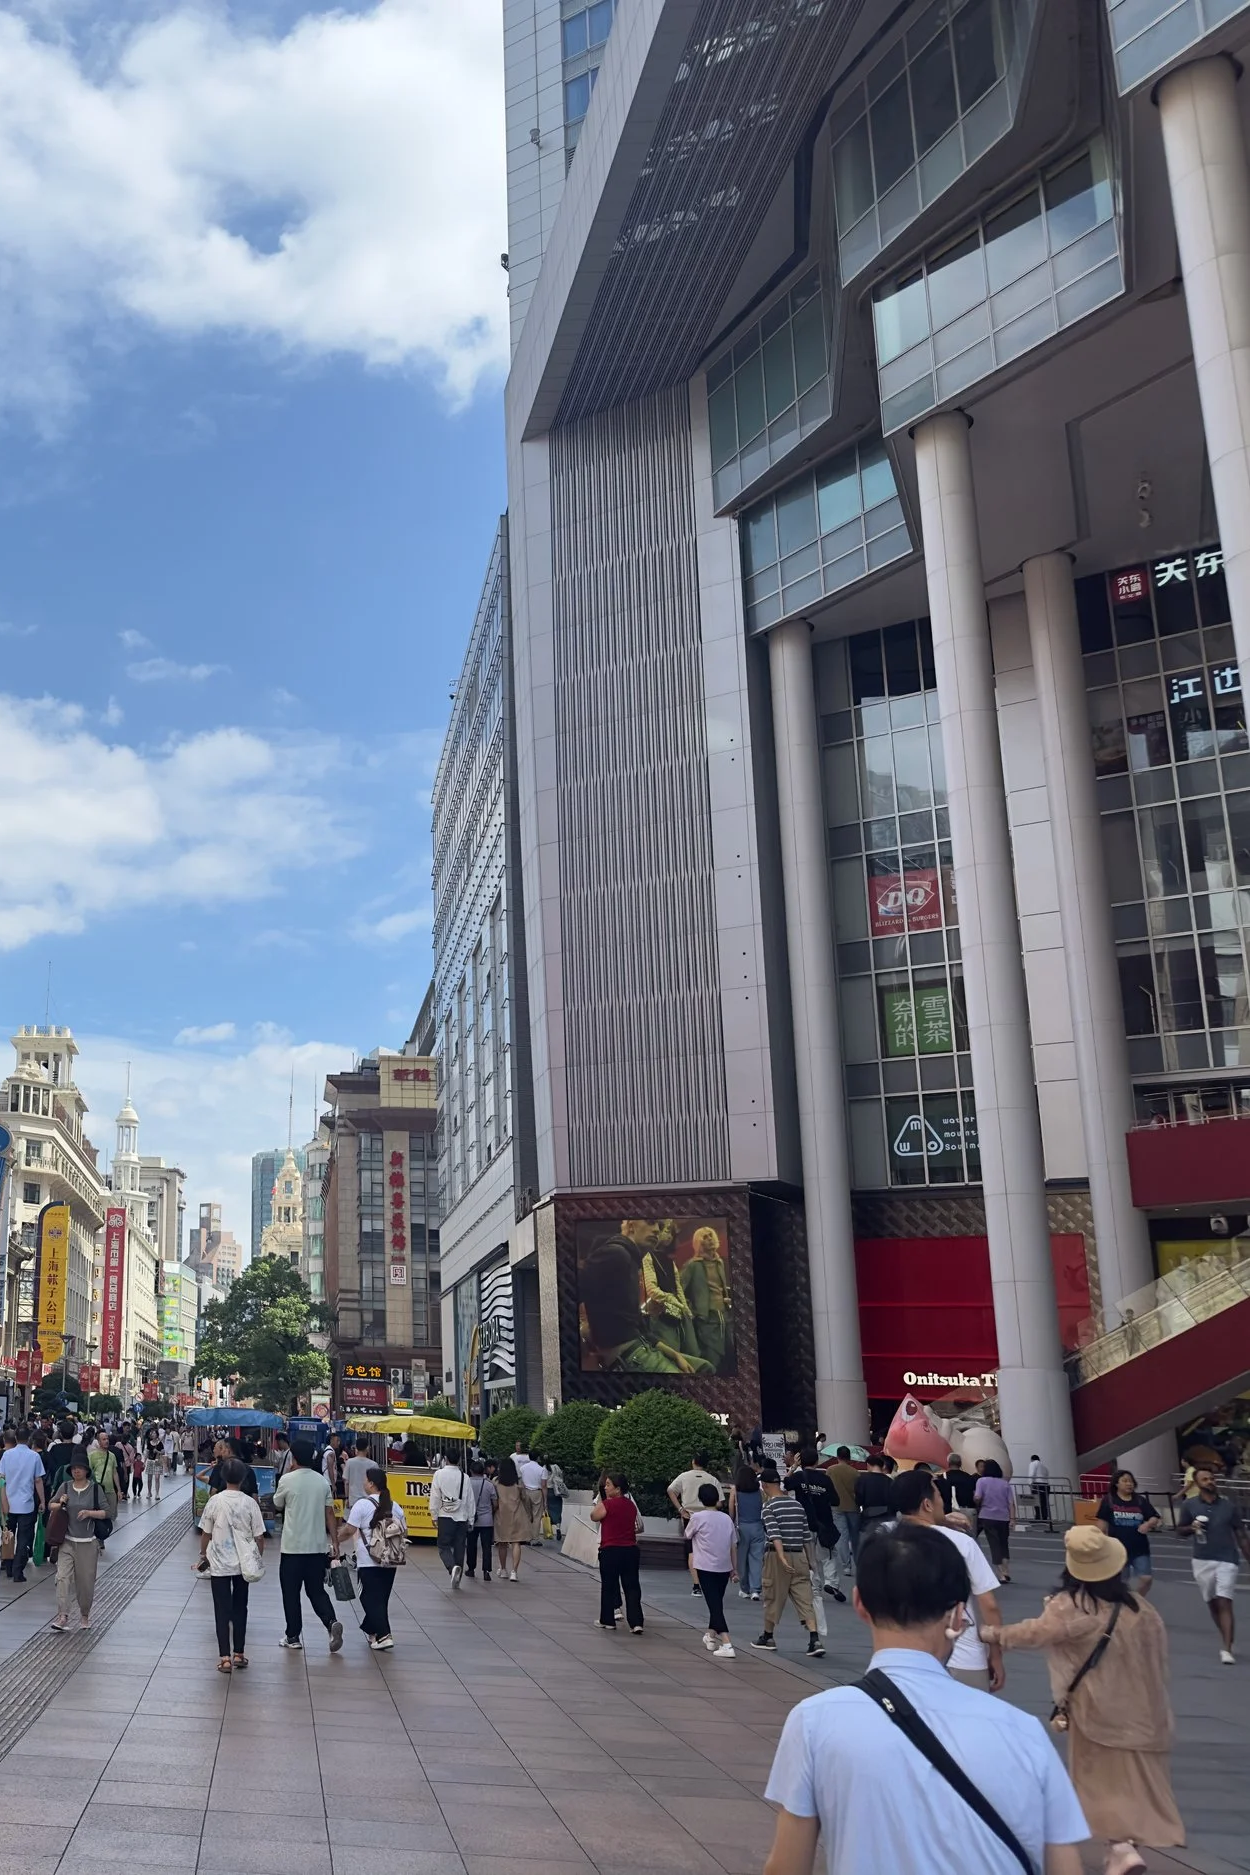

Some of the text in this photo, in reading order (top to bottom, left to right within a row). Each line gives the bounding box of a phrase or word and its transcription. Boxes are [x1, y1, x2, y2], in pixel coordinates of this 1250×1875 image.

[1154, 550, 1225, 588] 关东
[1117, 574, 1141, 587] 关东
[1170, 666, 1242, 705] 江边
[885, 887, 927, 909] DQ
[875, 917, 906, 928] BLIZZARD
[912, 913, 940, 922] BURGERS
[944, 1130, 979, 1138] mount
[345, 1365, 382, 1377] 汤包馆
[903, 1372, 981, 1386] Onitsuka
[708, 1413, 730, 1426] er
[406, 1481, 431, 1496] m&
